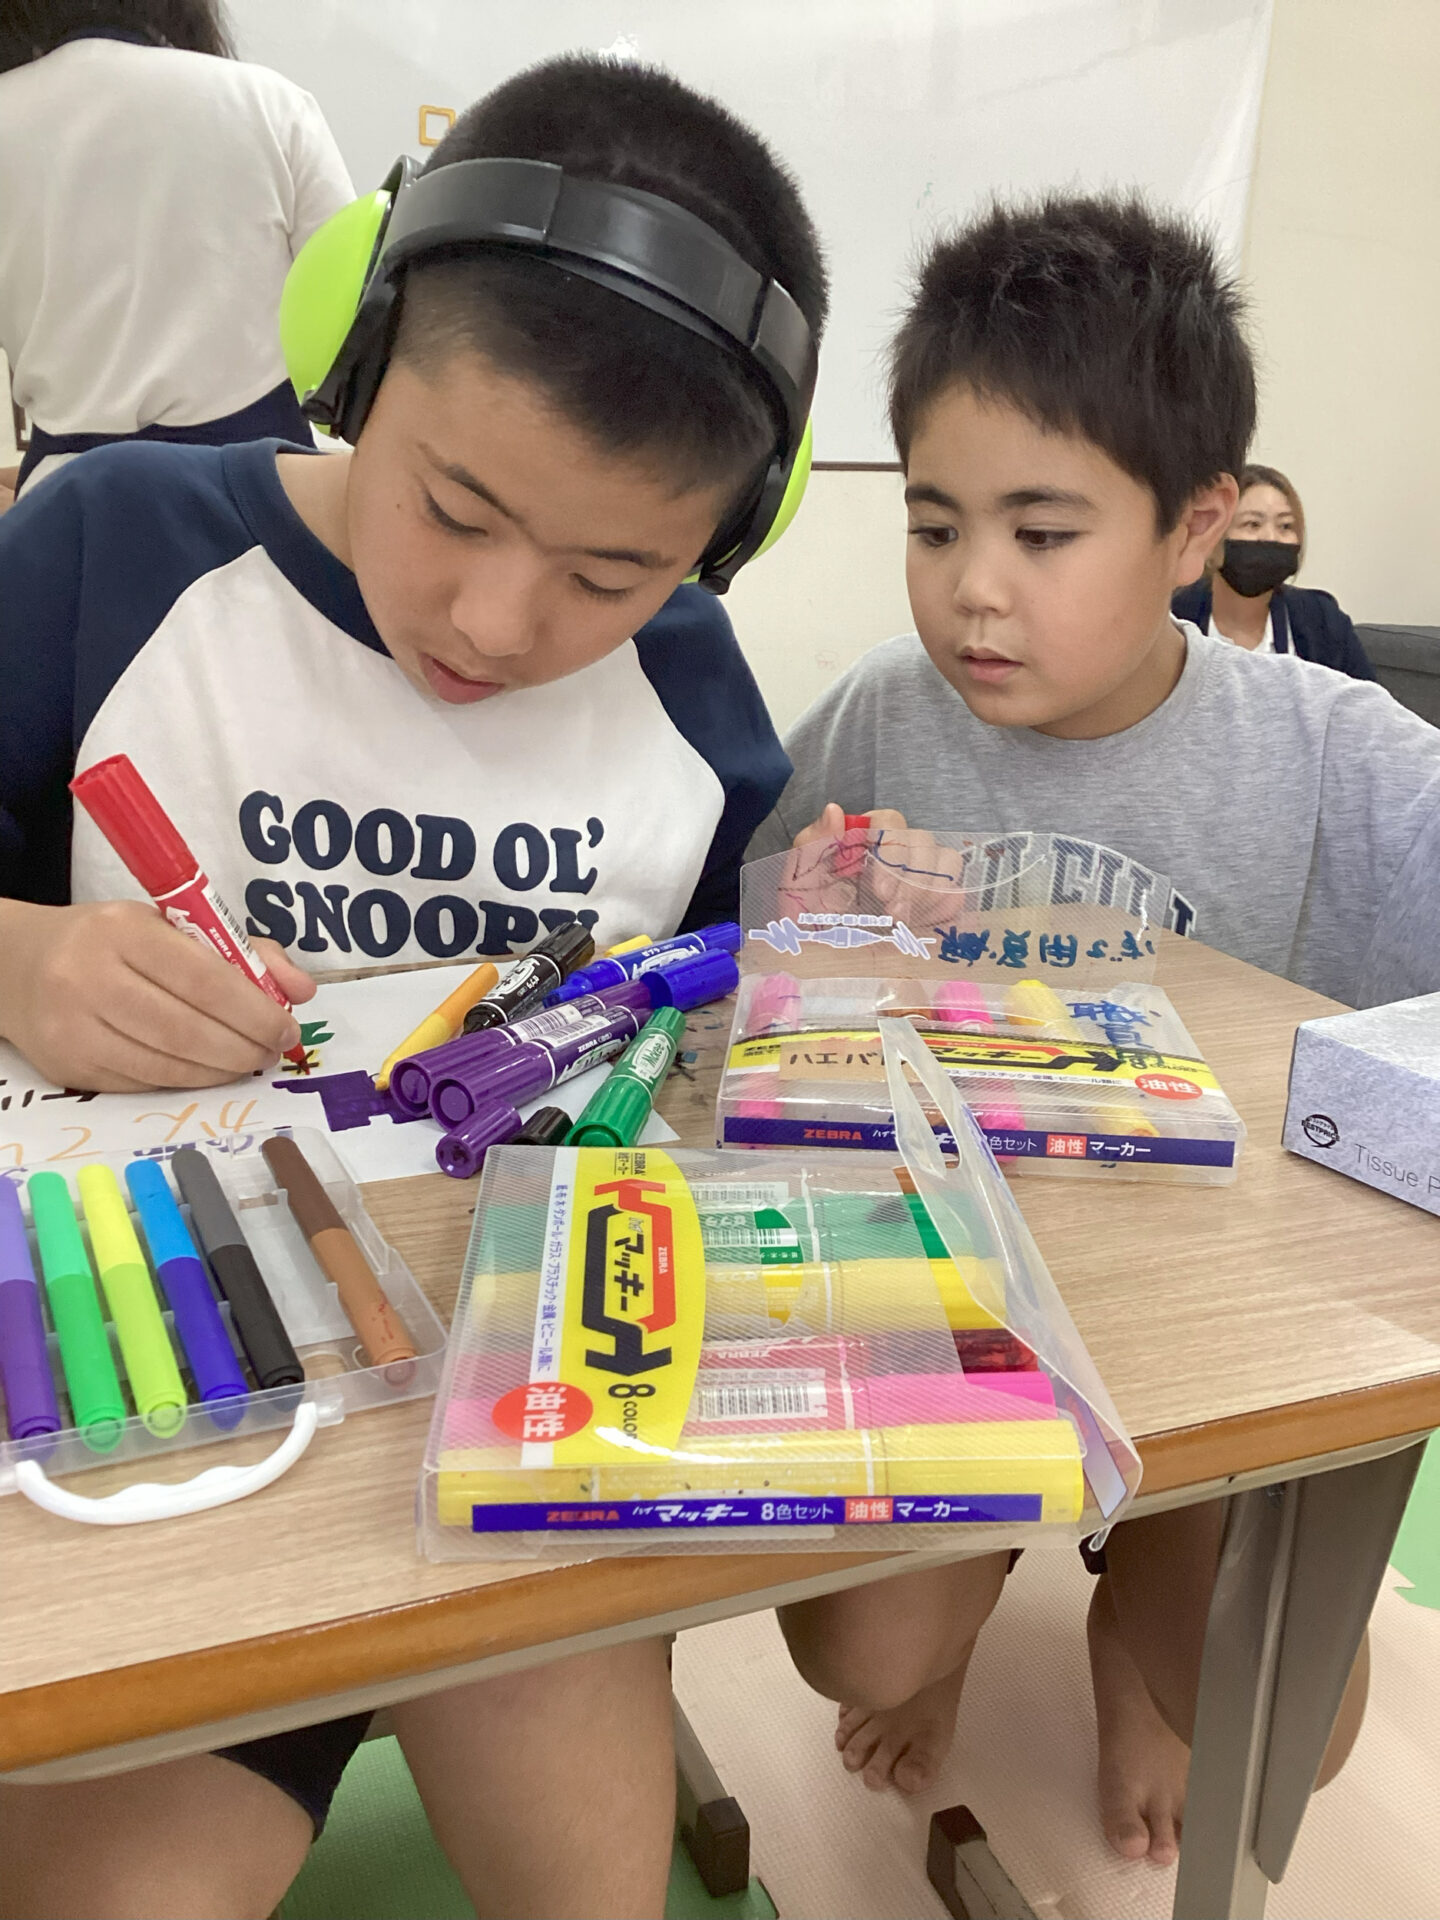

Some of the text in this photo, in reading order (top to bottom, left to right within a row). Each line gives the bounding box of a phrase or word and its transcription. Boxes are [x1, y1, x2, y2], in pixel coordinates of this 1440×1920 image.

[238, 789, 477, 881] GOOD
[1141, 1077, 1200, 1095] 油性
[803, 1128, 862, 1141] ZEBRA
[1049, 1137, 1085, 1155] 油性
[1089, 1140, 1152, 1158] マーカー
[633, 1151, 646, 1176] ZEBRA
[1353, 1143, 1419, 1188] Tissue
[657, 1246, 669, 1275] ZEBRA
[607, 1383, 657, 1400] 8
[523, 1386, 567, 1439] 油性
[546, 1510, 620, 1522] ZEBRA
[848, 1501, 890, 1520] 油性
[896, 1500, 970, 1519] マーカー
